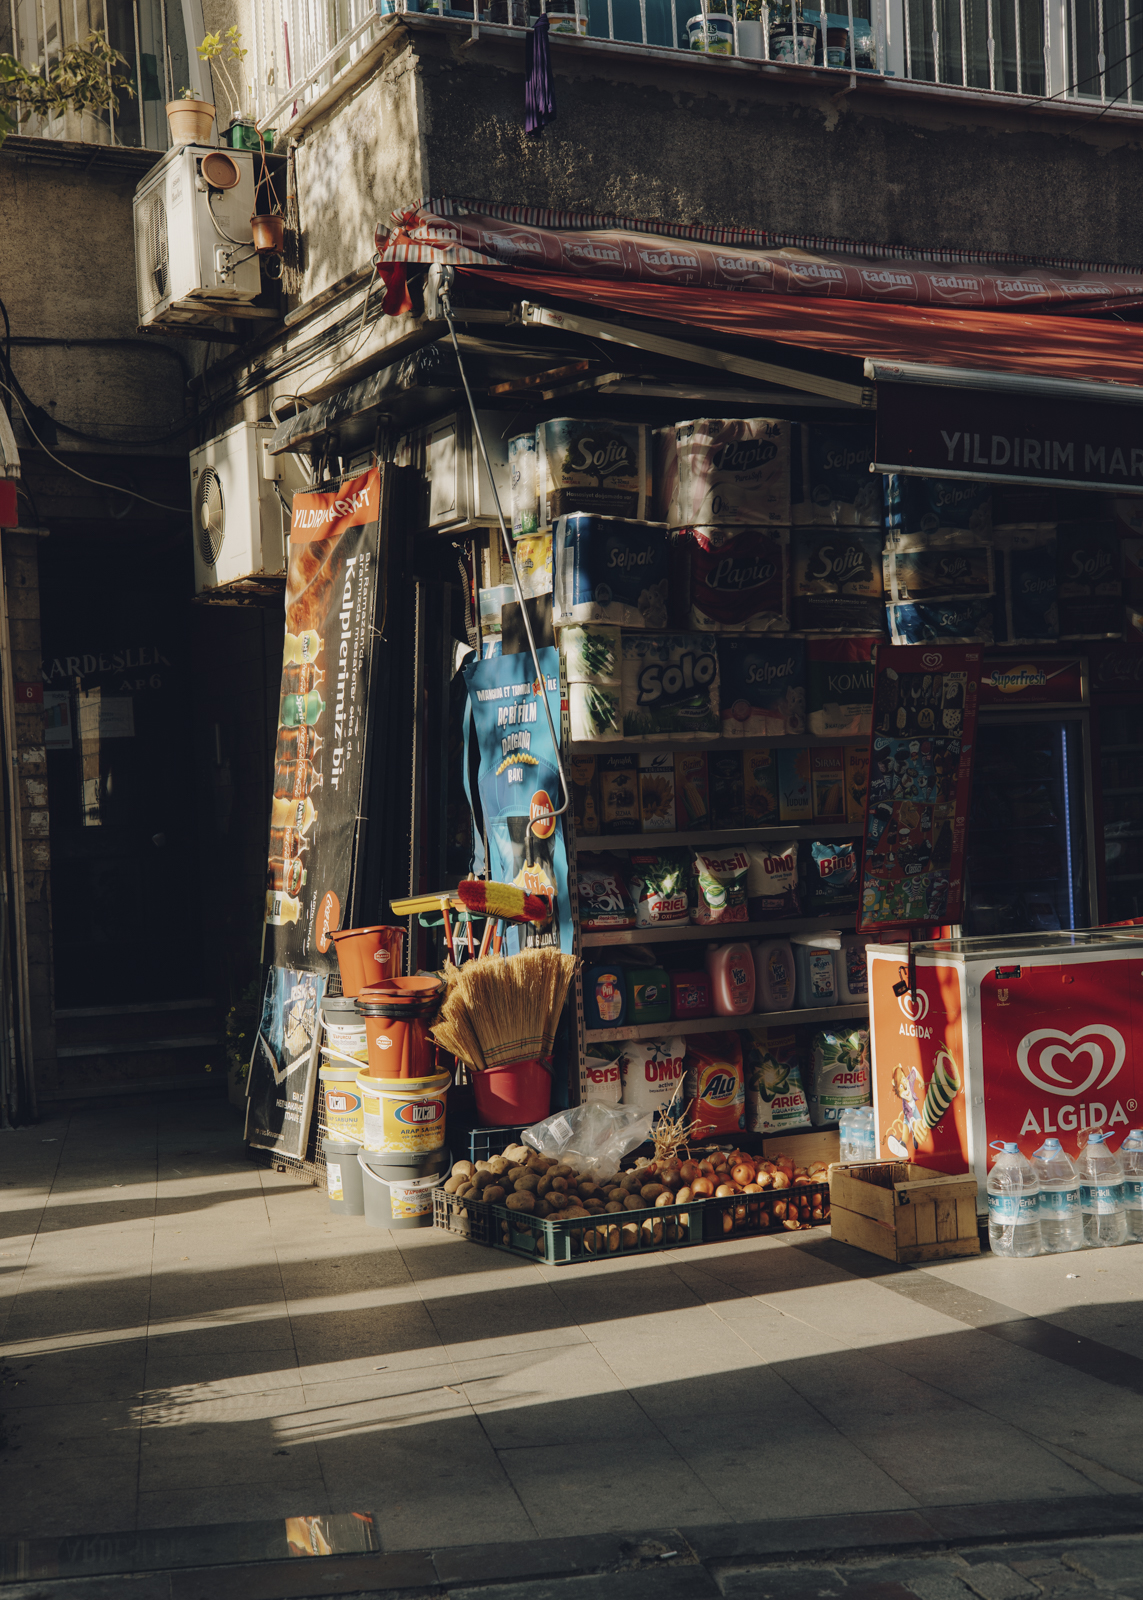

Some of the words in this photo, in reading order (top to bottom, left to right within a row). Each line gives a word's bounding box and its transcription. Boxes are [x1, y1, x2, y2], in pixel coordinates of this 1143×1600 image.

[564, 240, 621, 262] tadım
[641, 249, 697, 267] tadım
[788, 261, 844, 280] tadım
[861, 268, 913, 286] tadım
[929, 275, 979, 291] tadım
[996, 280, 1046, 294] tadım
[571, 438, 628, 471] Sofia
[718, 438, 775, 471] Papia
[823, 446, 873, 471] Selpak
[940, 429, 1074, 472] YILDIRIM
[938, 483, 977, 507] Selpak
[364, 552, 371, 571] Bu
[607, 546, 655, 571] Selpak
[812, 545, 864, 579] Sofia
[940, 557, 966, 576] Sofia
[1069, 549, 1111, 580] Sofia
[712, 556, 772, 590] Papia
[939, 607, 972, 627] Selpak
[334, 556, 357, 739] Kalplerimiz
[746, 657, 795, 684] Selpak
[991, 670, 1046, 688] SuperFresh
[26, 687, 33, 698] 6
[517, 699, 537, 724] FİLM
[330, 748, 344, 791] bir
[683, 758, 703, 771] Bizim
[751, 757, 770, 768] Bizim
[815, 758, 841, 768] SIRMA
[507, 768, 523, 784] BAK!
[701, 853, 748, 873] Persil
[763, 855, 794, 874] OMO
[651, 899, 685, 911] ARIEL
[602, 984, 613, 997] Pril
[645, 1057, 683, 1082] OMO
[832, 1071, 867, 1085] ARIEL
[700, 1074, 736, 1099] ALO
[771, 1095, 805, 1109] ARIEL
[412, 1103, 436, 1122] özcan
[1019, 1197, 1037, 1207] Erikli
